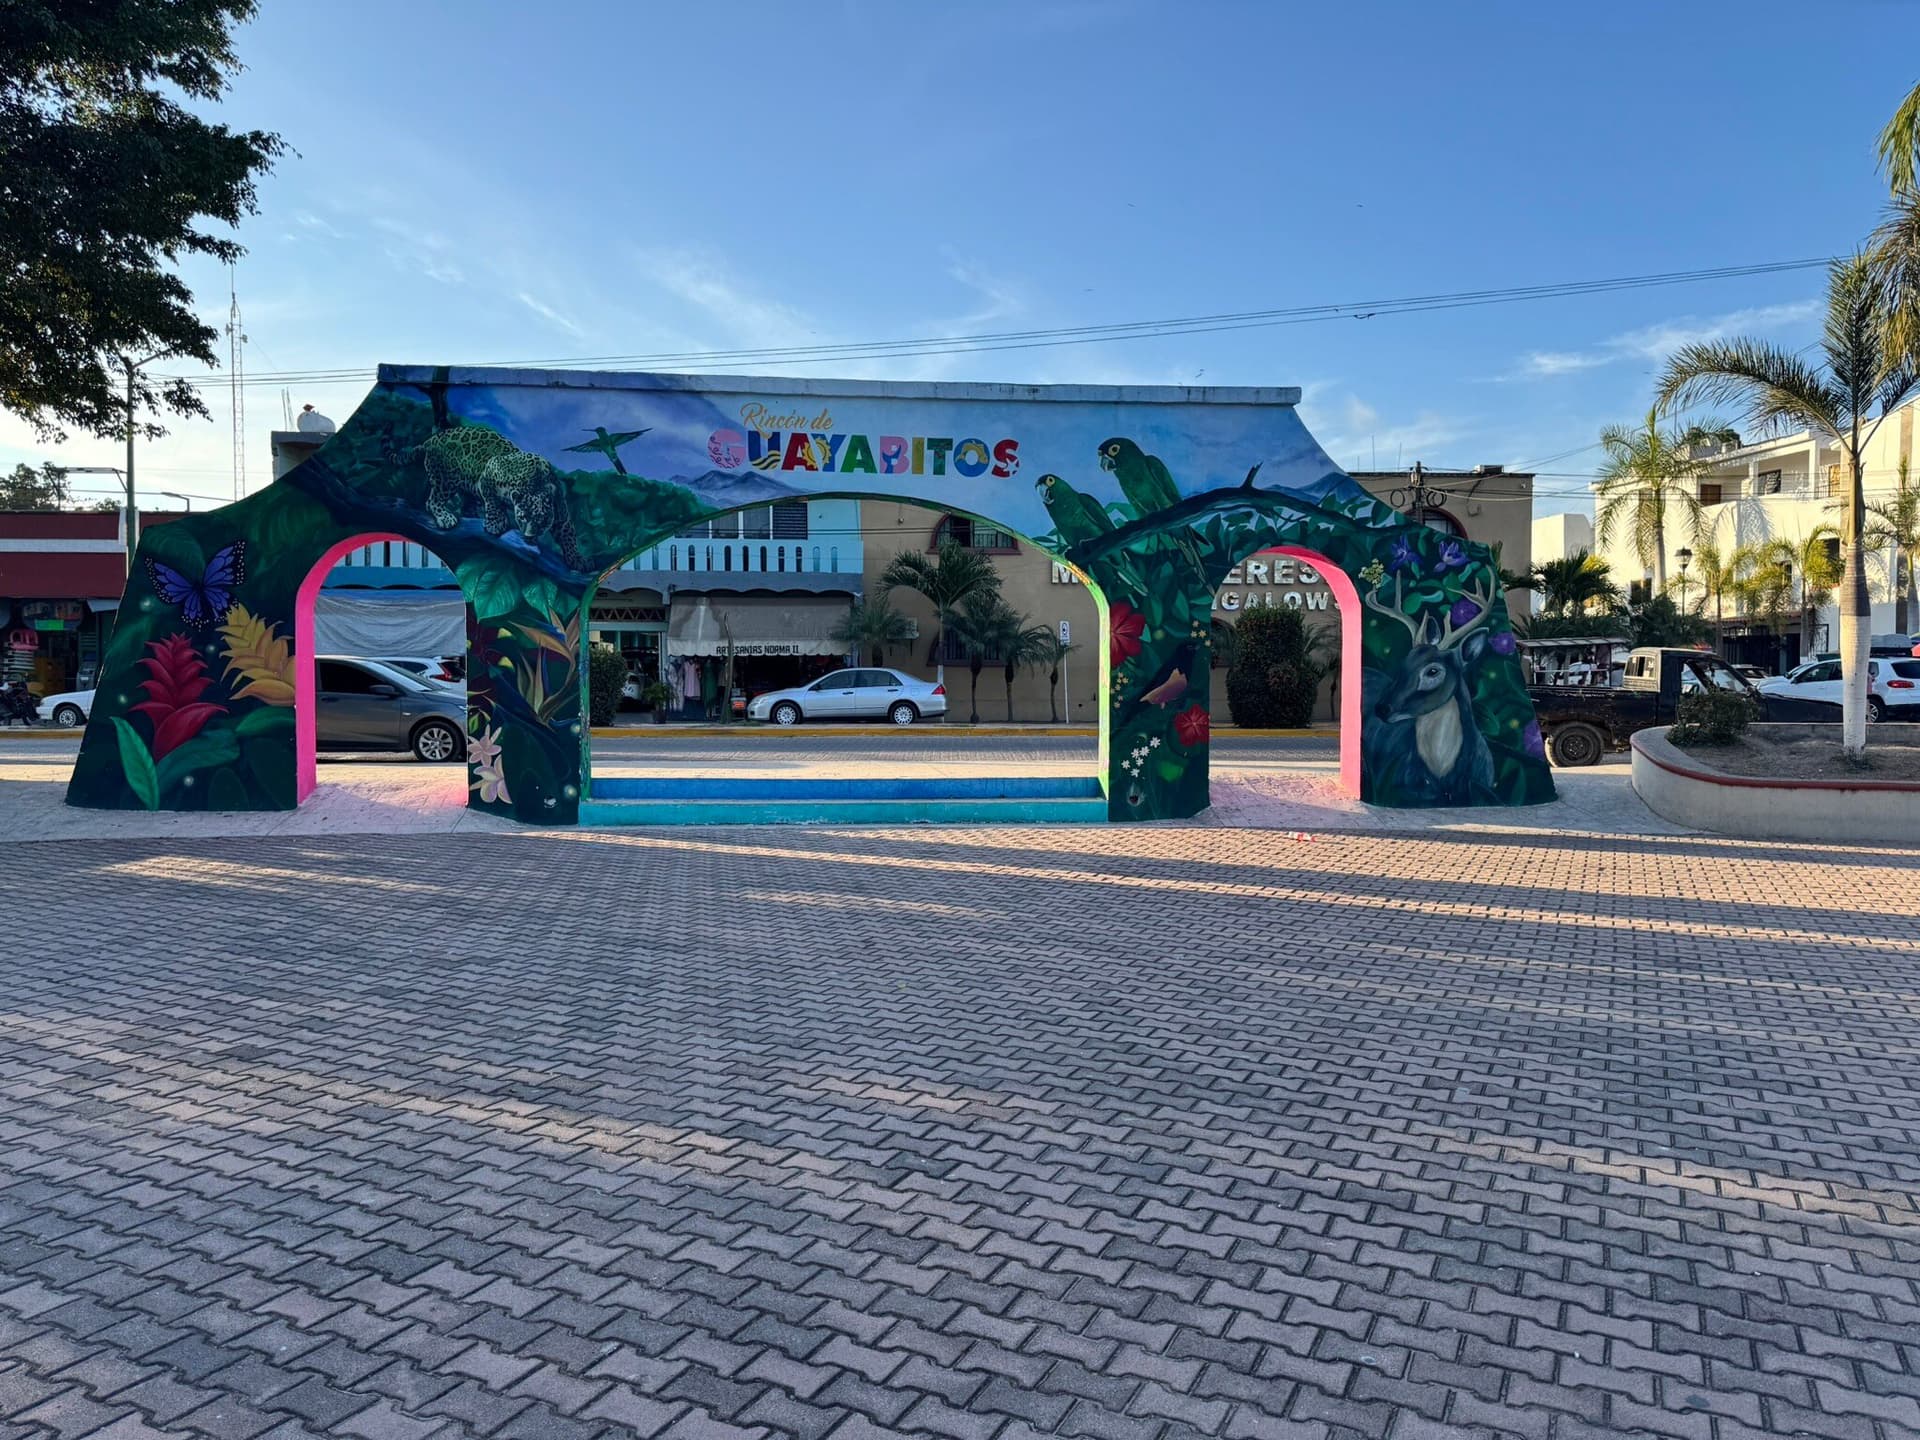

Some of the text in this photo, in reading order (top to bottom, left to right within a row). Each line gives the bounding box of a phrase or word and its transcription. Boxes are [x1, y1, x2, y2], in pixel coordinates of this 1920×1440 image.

[739, 402, 834, 431] Rincón de
[706, 427, 1021, 478] GUAYABITOS
[1211, 590, 1341, 611] GALOW
[764, 644, 791, 654] NORMA
